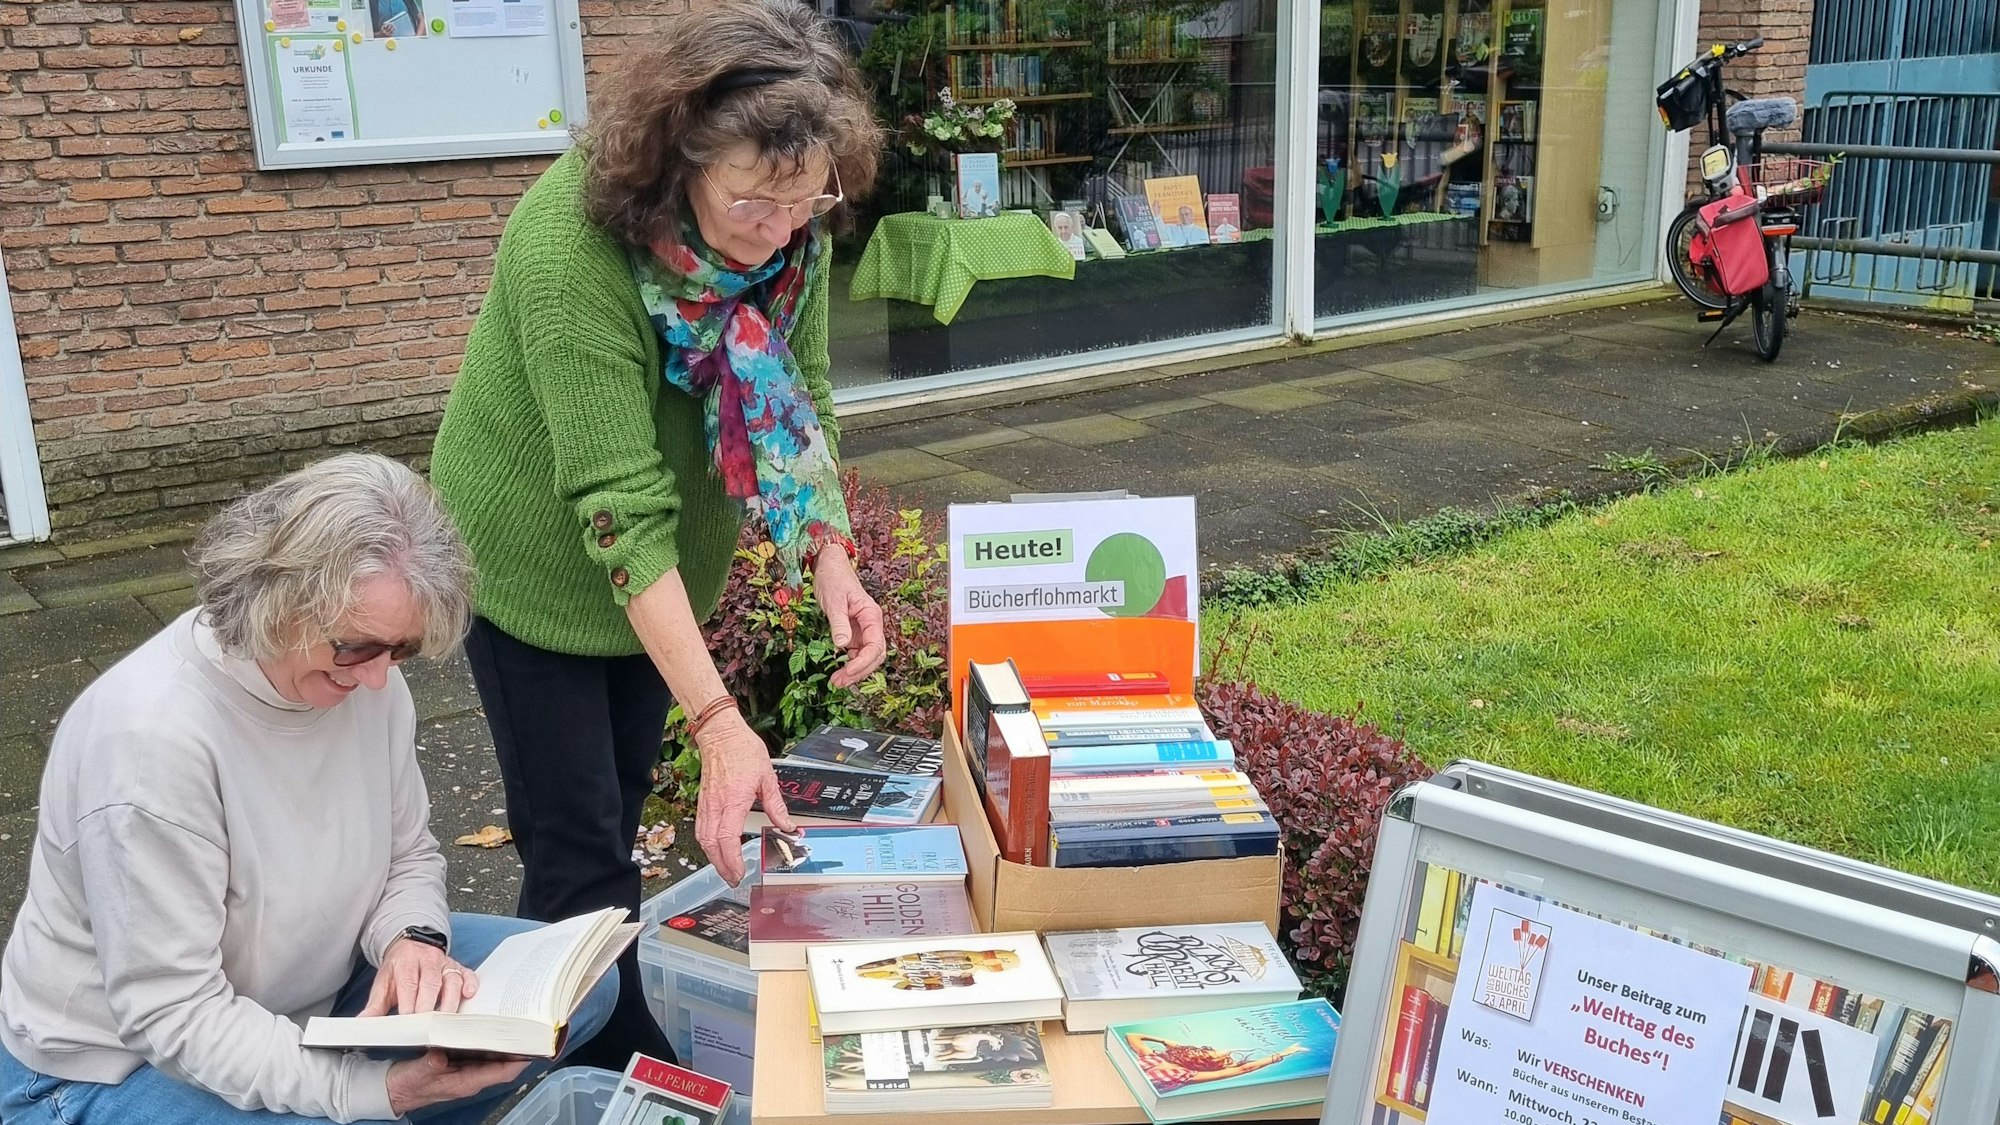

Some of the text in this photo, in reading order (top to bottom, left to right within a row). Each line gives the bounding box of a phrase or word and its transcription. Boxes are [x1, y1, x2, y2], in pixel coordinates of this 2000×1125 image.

[1511, 12, 1531, 22] GEO
[975, 538, 1062, 560] Heute!
[969, 586, 1118, 608] Bücherflohmarkt
[1090, 699, 1138, 707] Marokko
[872, 739, 916, 772] WIEDER
[891, 739, 935, 774] ZAUBERT
[862, 894, 896, 926] HILL
[896, 884, 926, 936] GOLDEN
[1151, 962, 1166, 988] HALL
[1486, 978, 1529, 998] DES BUCHES
[1488, 964, 1531, 986] WELTTAG
[1577, 969, 1707, 1024] Unser Beitrag zum
[1249, 1007, 1307, 1040] Himmel
[1461, 1028, 1492, 1050] Was:
[1570, 996, 1696, 1050] „Welttag des
[1584, 1027, 1670, 1071] Buches“!
[1892, 1032, 1920, 1076] IMPERIUM
[664, 1074, 708, 1097] PEARCE
[1457, 1068, 1498, 1094] Wann:
[1518, 1049, 1646, 1108] Wir VERSCHENKEN
[1508, 1089, 1576, 1125] Mittwoch,
[1512, 1068, 1658, 1125] Bücher aus unserem Besta
